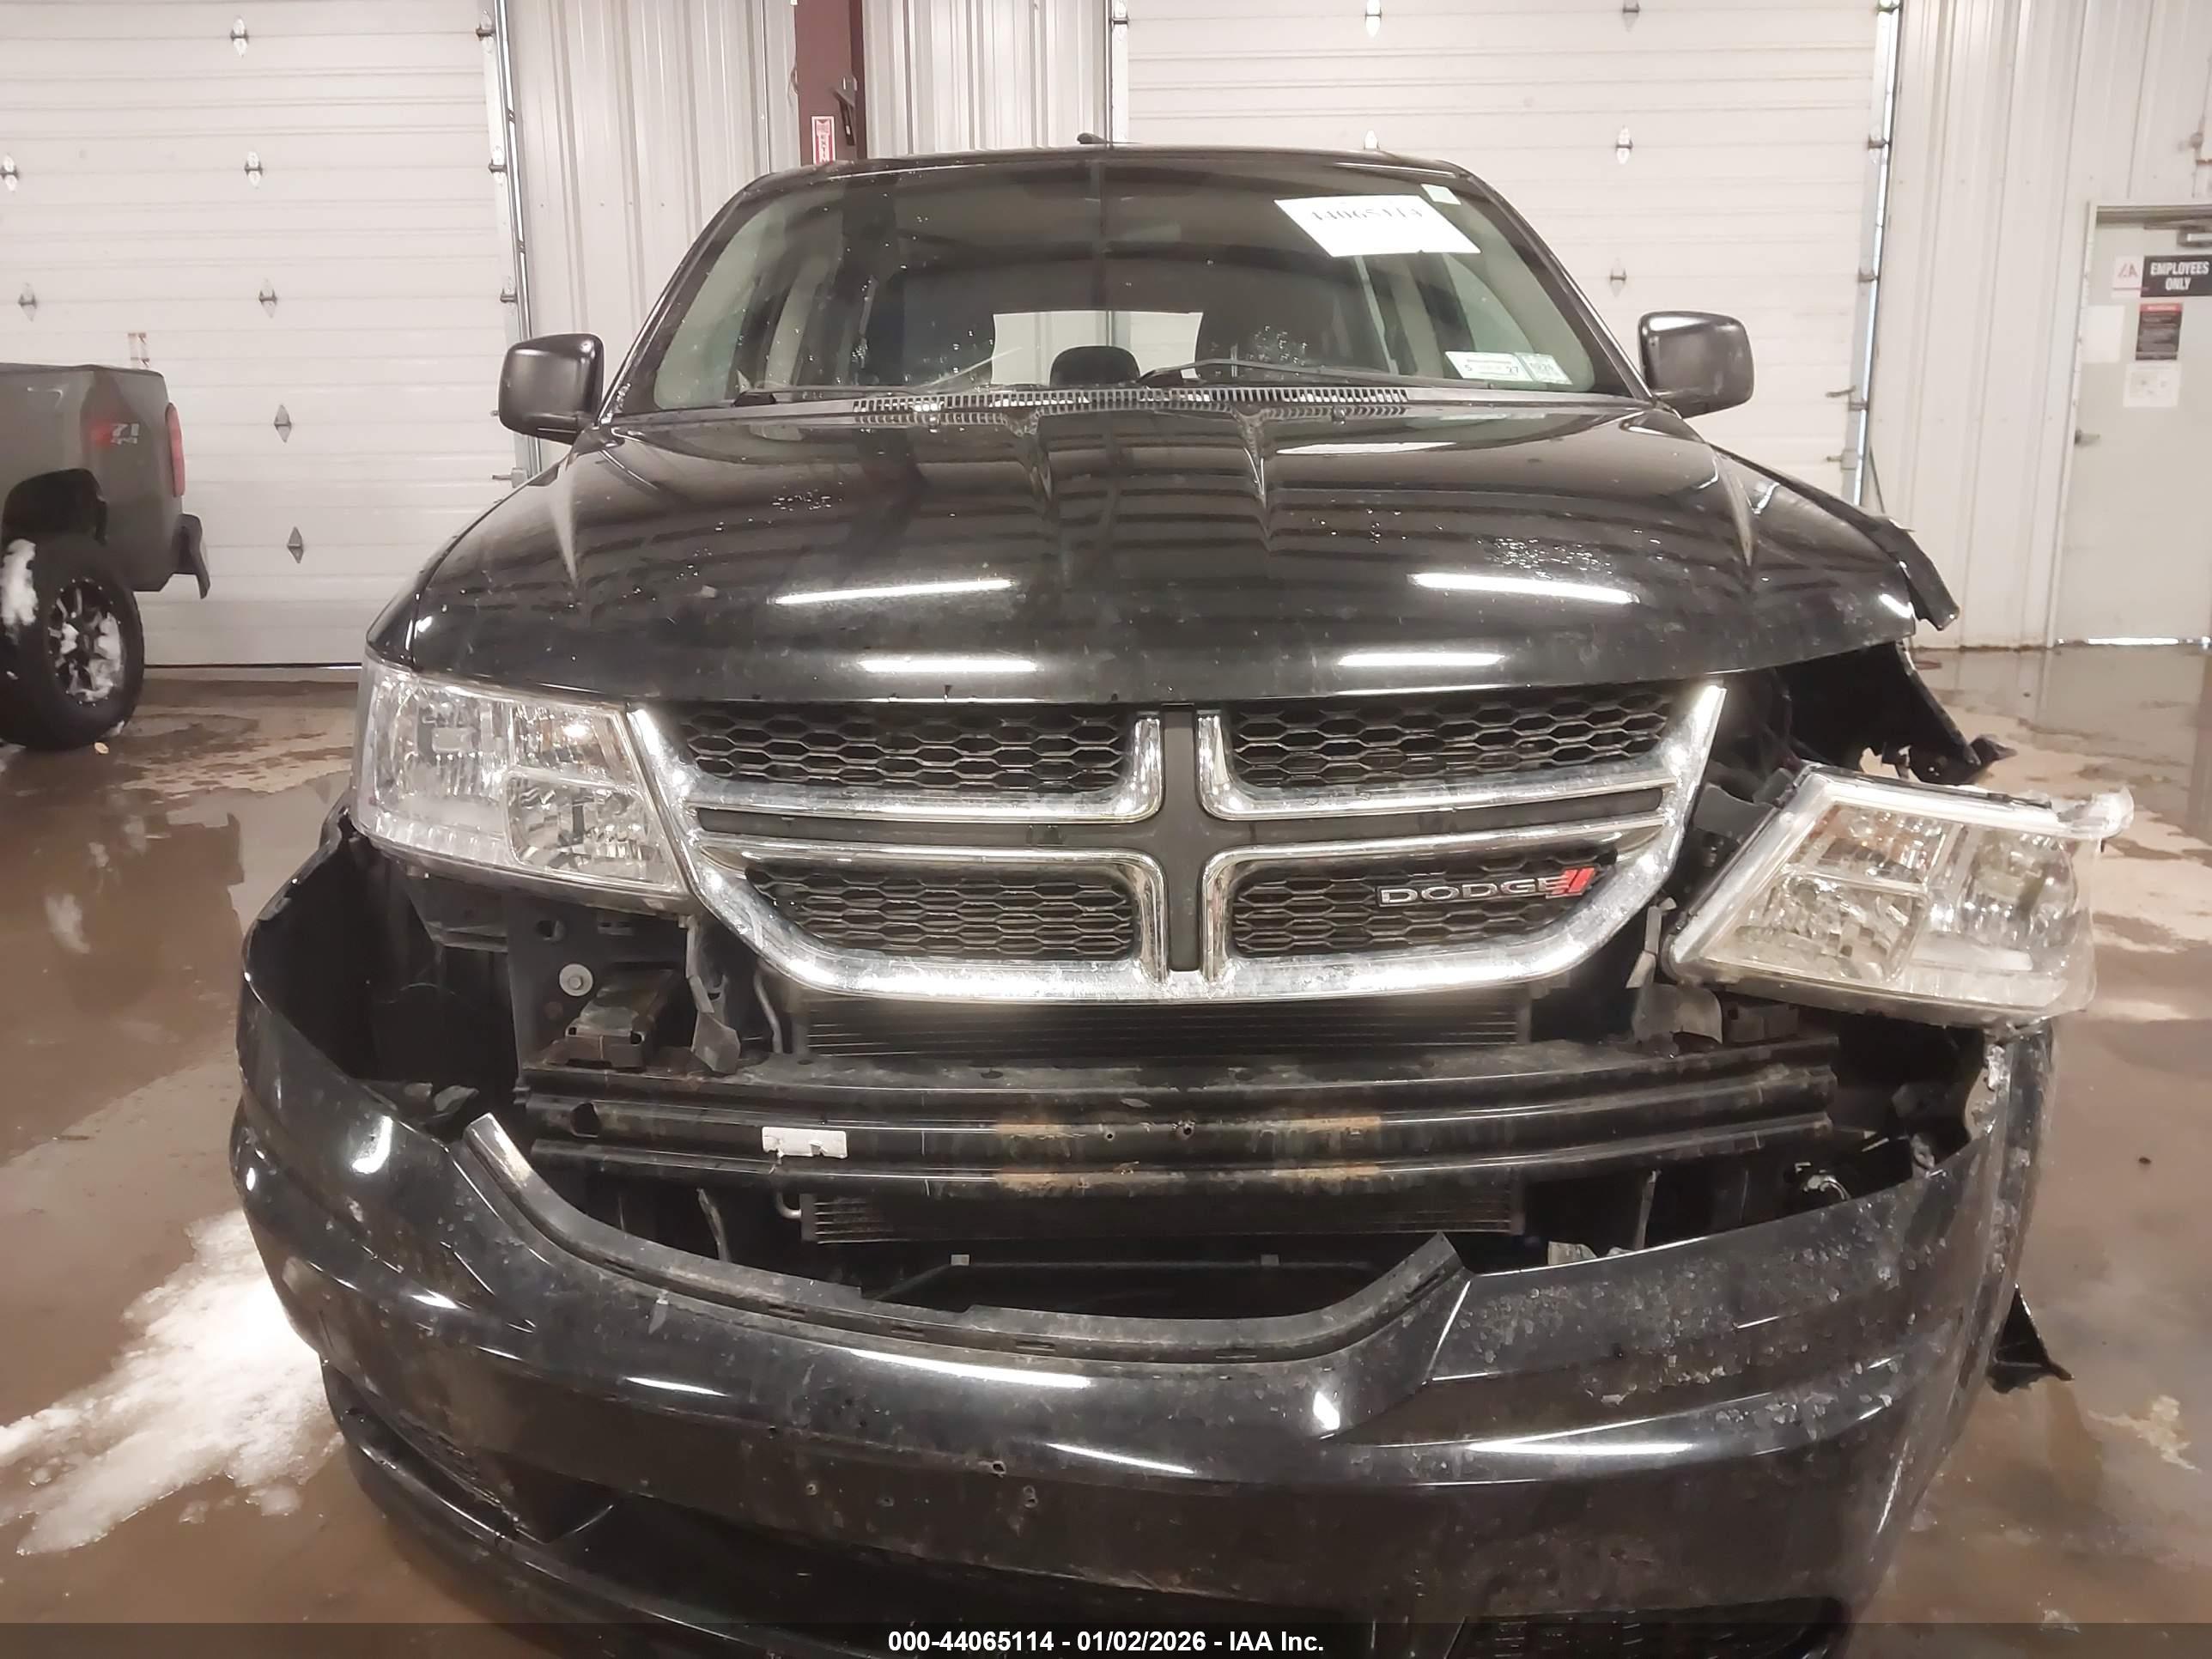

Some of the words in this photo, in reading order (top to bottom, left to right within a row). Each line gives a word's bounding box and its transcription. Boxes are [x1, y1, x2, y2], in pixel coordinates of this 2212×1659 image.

[2150, 261, 2210, 276] EMPLOYEES
[2165, 276, 2191, 291] ONLY
[1380, 877, 1569, 903] DODGE
